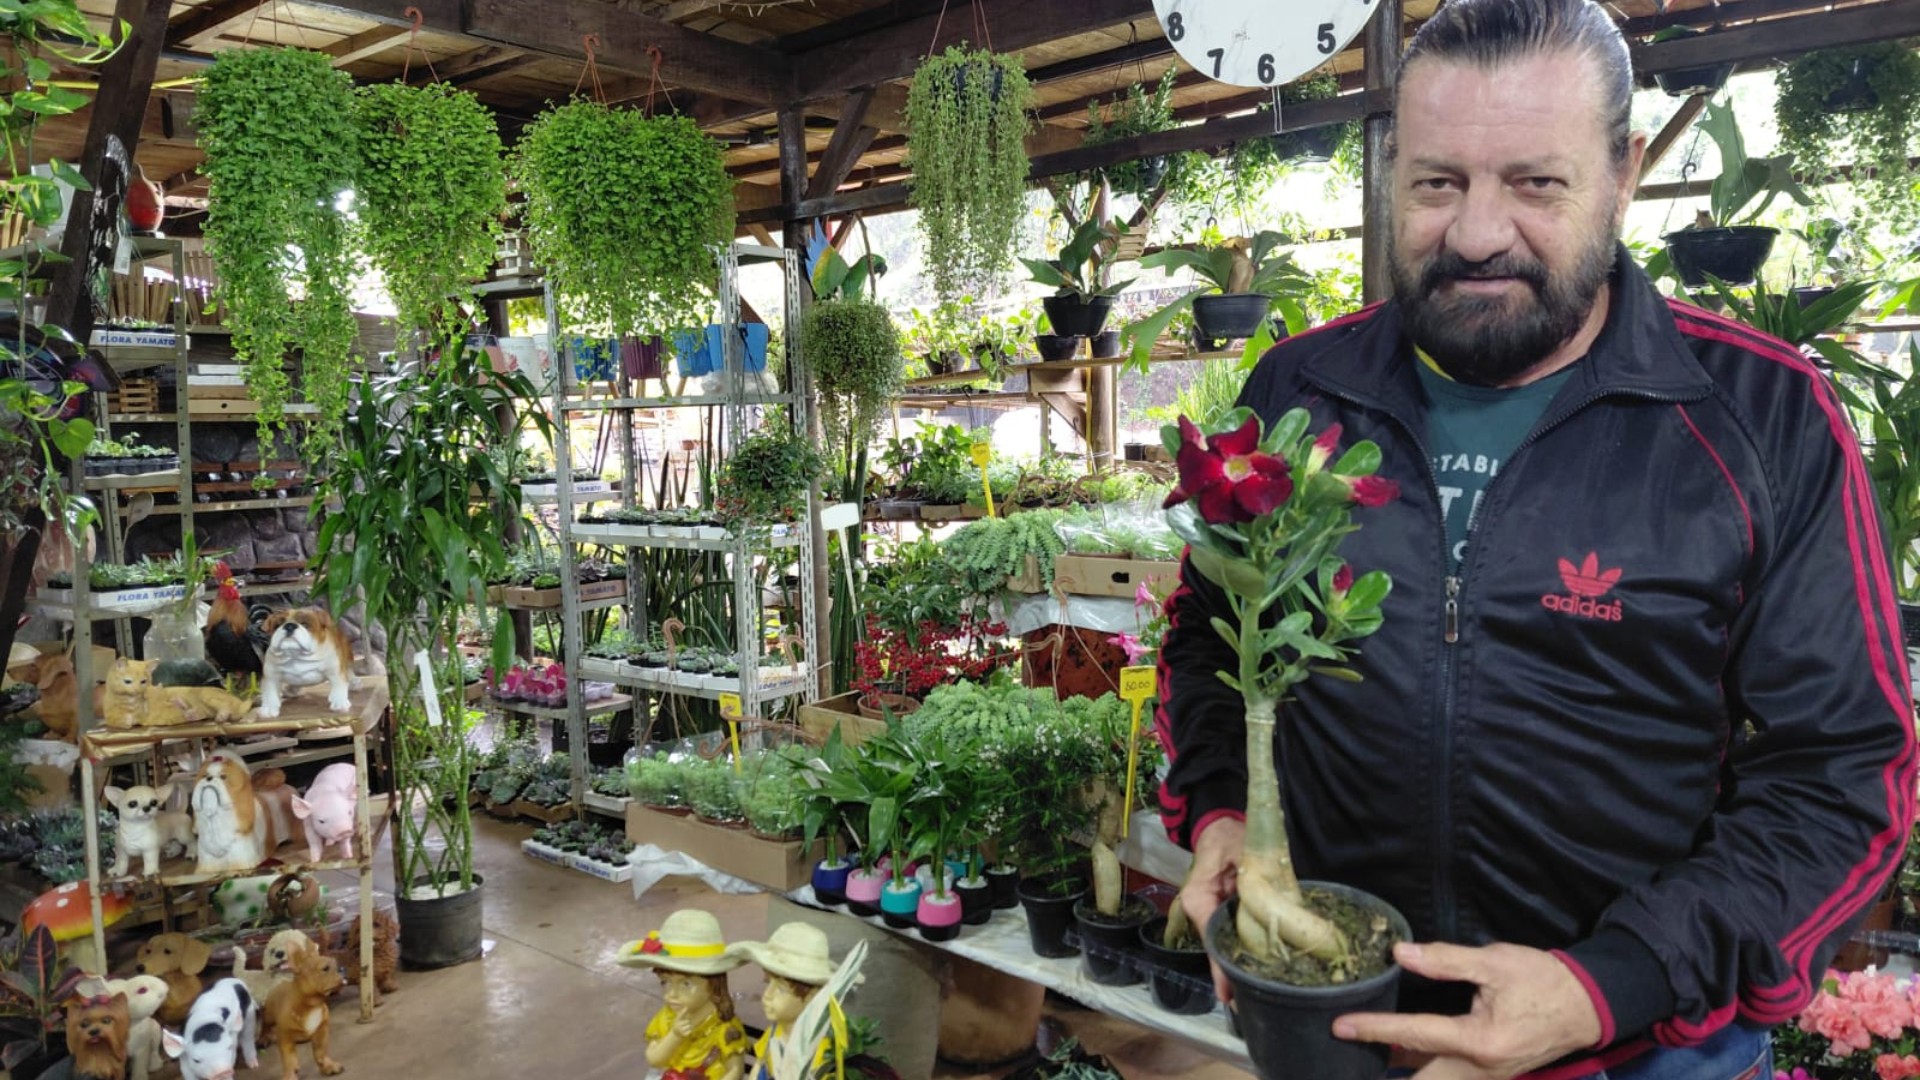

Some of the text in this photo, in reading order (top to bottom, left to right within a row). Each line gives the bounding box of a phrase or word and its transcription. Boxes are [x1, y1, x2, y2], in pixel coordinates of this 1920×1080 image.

[1167, 12, 1185, 42] 8
[1317, 23, 1337, 54] 5
[1207, 48, 1224, 78] 7
[1257, 53, 1276, 84] 6
[100, 335, 176, 346] FLORA YAMATO
[116, 592, 149, 602] FLORA
[1541, 593, 1623, 622] adidas
